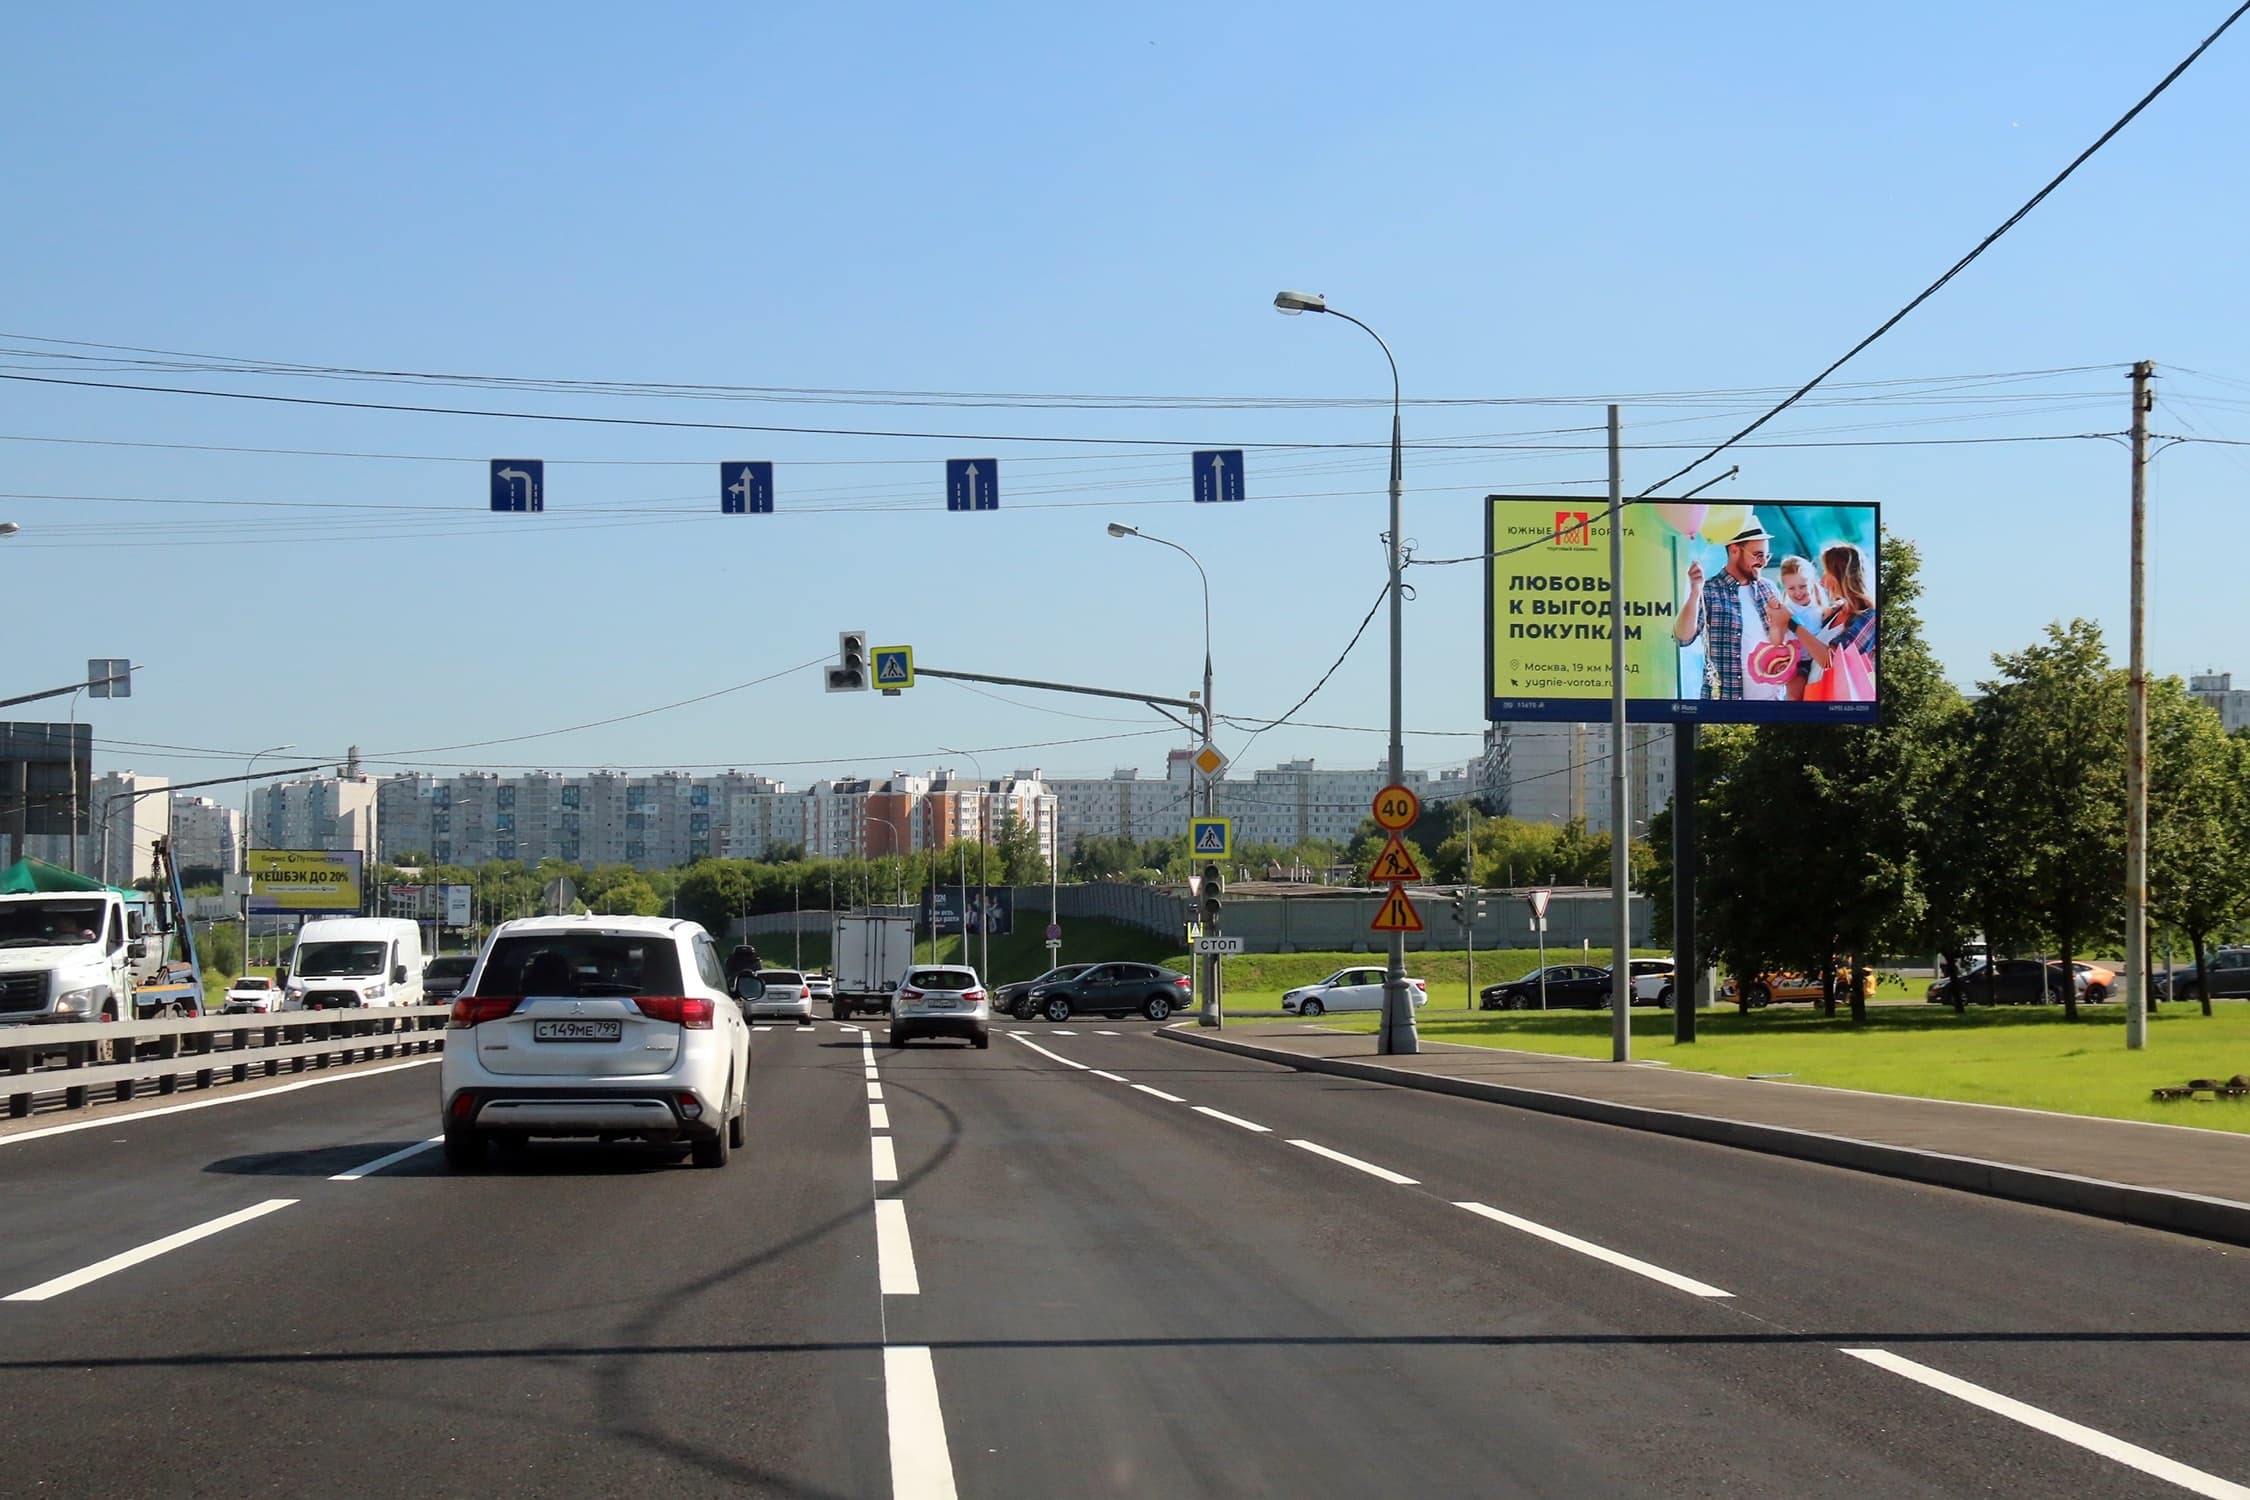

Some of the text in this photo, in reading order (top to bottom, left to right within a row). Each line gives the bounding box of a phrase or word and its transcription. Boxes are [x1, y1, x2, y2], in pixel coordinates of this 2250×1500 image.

[1507, 526, 1635, 537] ЮЖНЫЕ ВОРТА
[1508, 575, 1612, 592] ЛЮБОВЬ
[1509, 599, 1524, 615] К
[1524, 663, 1640, 674] Москва, 19 км МАД
[1382, 799, 1409, 817] 40
[256, 871, 349, 884] КЕШБЭК ДО 20%
[1200, 940, 1237, 950] СТОП
